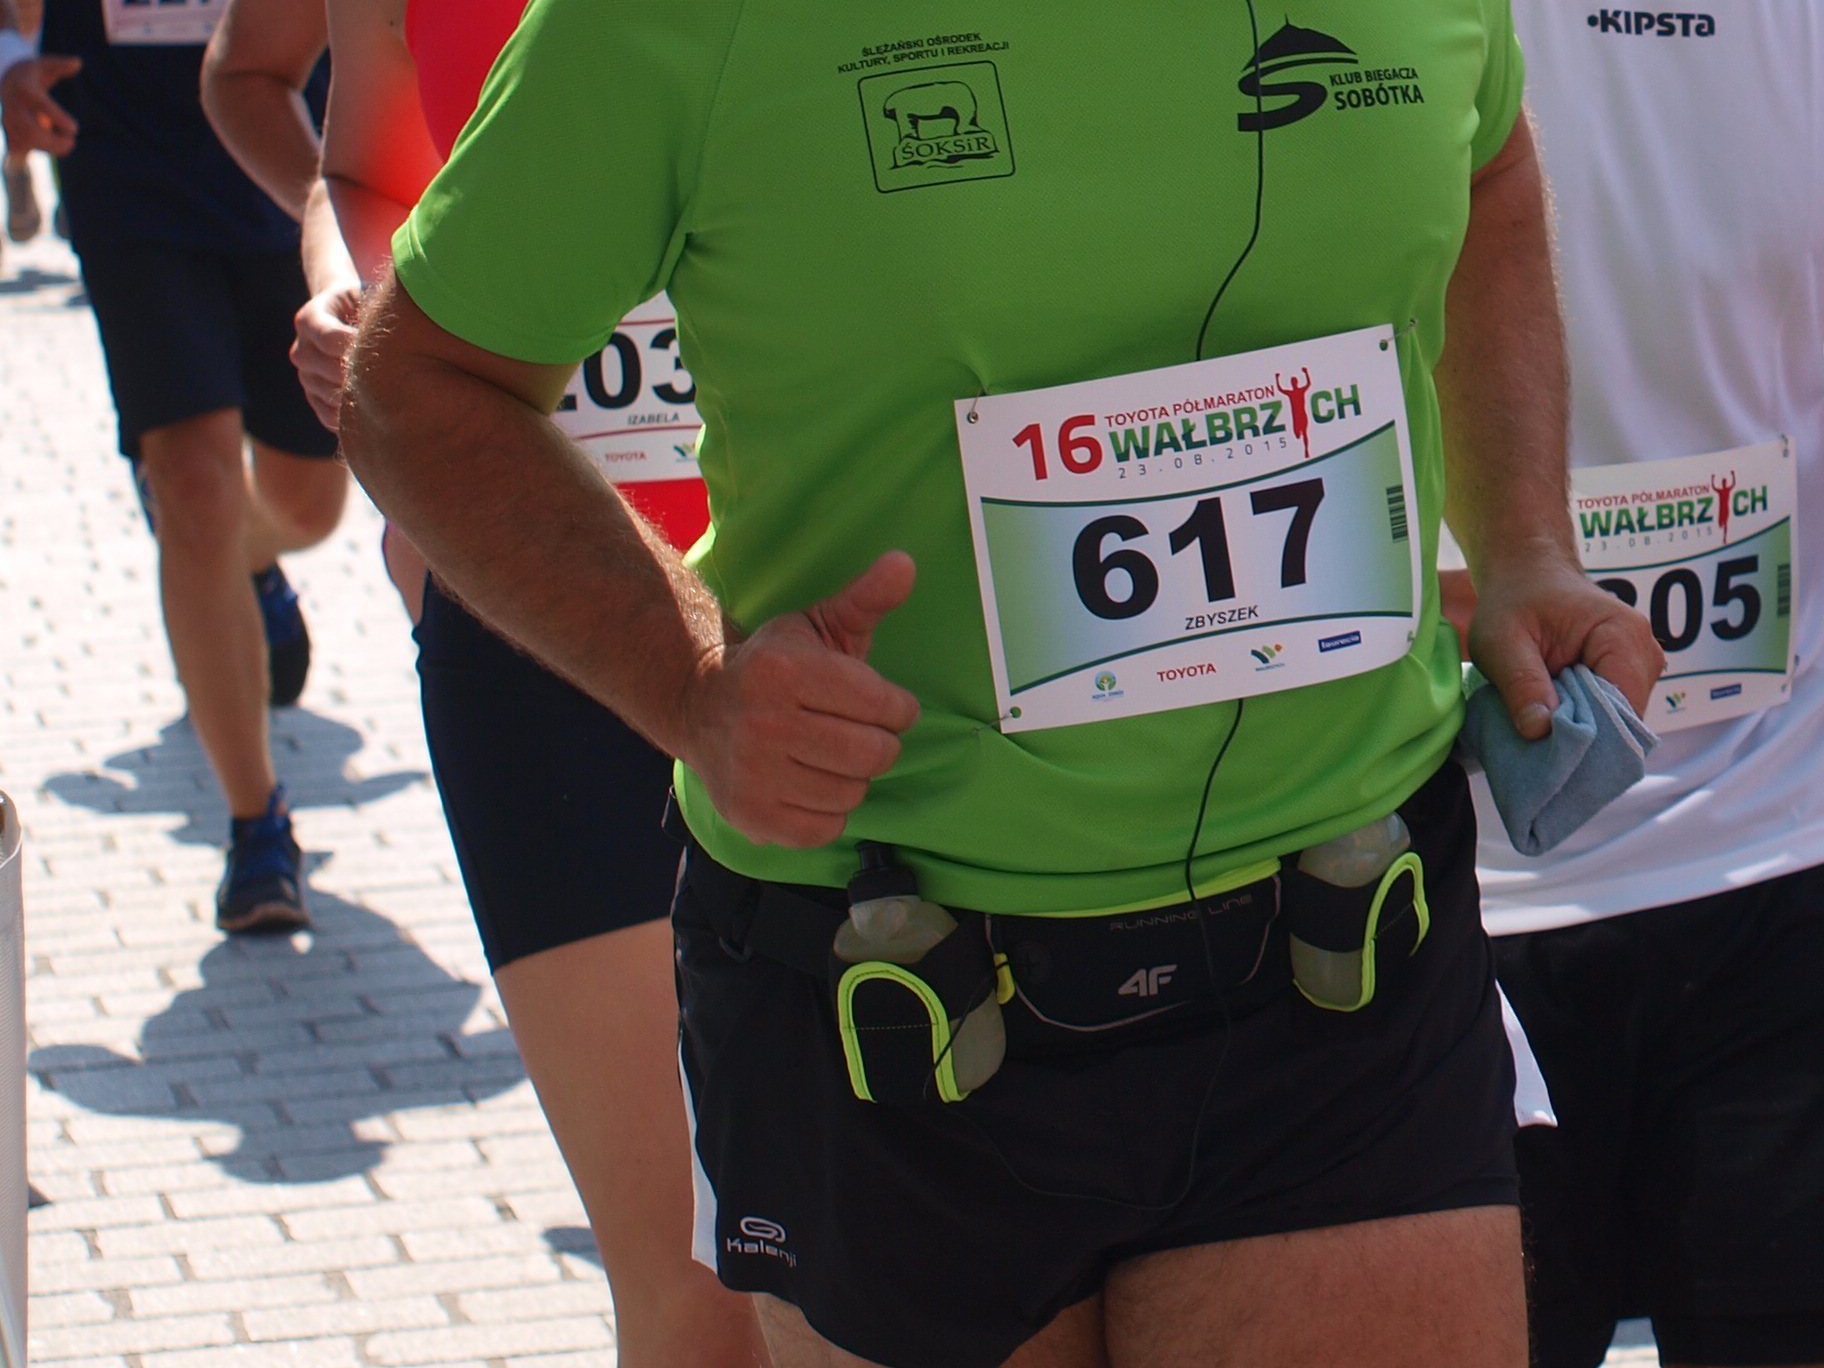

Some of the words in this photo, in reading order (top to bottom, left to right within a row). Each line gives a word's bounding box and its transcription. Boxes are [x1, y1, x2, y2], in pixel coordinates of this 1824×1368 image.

[894, 48, 938, 63] SPORTU
[941, 48, 946, 56] I
[948, 41, 1009, 56] REKREACJI
[927, 33, 982, 46] OŚRODEK
[1329, 72, 1362, 86] KLUB
[1364, 67, 1419, 83] BIEGACZA
[1334, 82, 1425, 110] SOBÓTKA
[556, 328, 697, 411] 03
[627, 412, 680, 426] IZABELA
[1104, 407, 1169, 428] TOYOTA
[1173, 385, 1275, 420] PÓŁMARATON
[605, 450, 647, 463] TOYOTA
[1012, 414, 1103, 481] 16
[1577, 496, 1628, 509] TOYOTA
[1632, 484, 1710, 504] PÓŁMARATON
[1072, 477, 1326, 621] 617
[1596, 554, 1762, 653] 05
[1185, 605, 1260, 630] ZBYSZEK
[1157, 663, 1217, 682] TOYOTA
[1118, 964, 1178, 997] 4F
[726, 1238, 797, 1268] Kalenji
